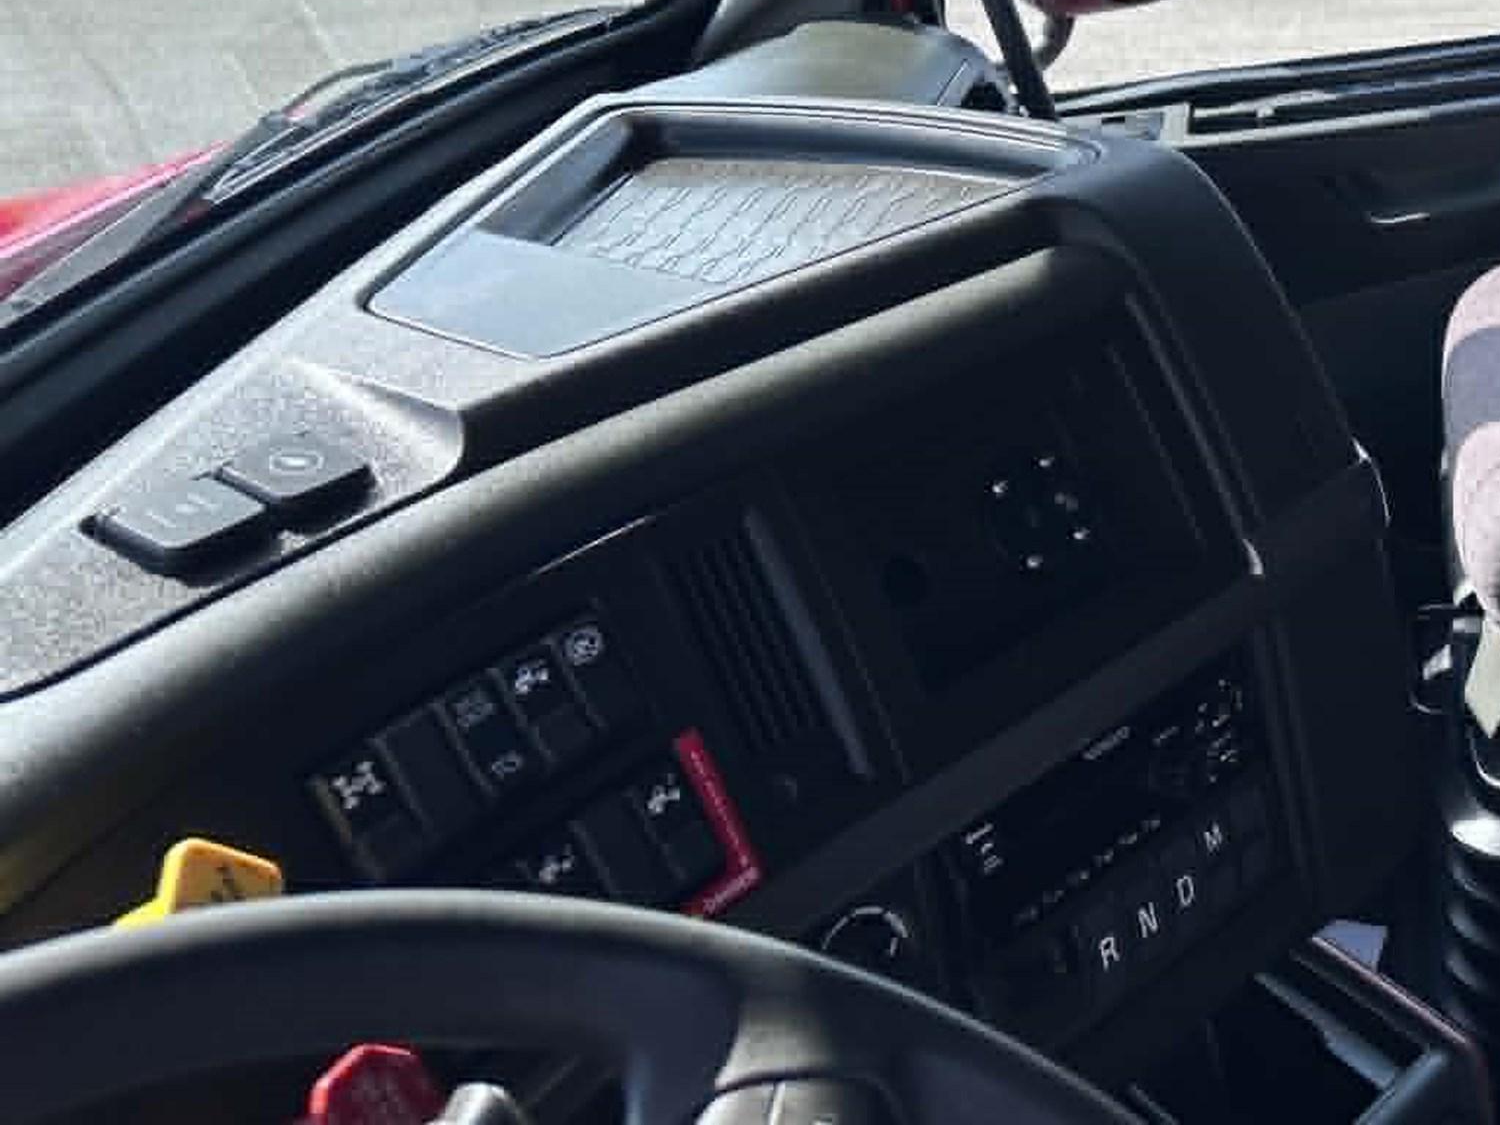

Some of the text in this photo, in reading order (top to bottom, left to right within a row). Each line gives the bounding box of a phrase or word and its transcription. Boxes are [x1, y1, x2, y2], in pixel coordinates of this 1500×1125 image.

[1099, 935, 1120, 971] R
[1137, 901, 1159, 939] N
[1175, 874, 1195, 907] D
